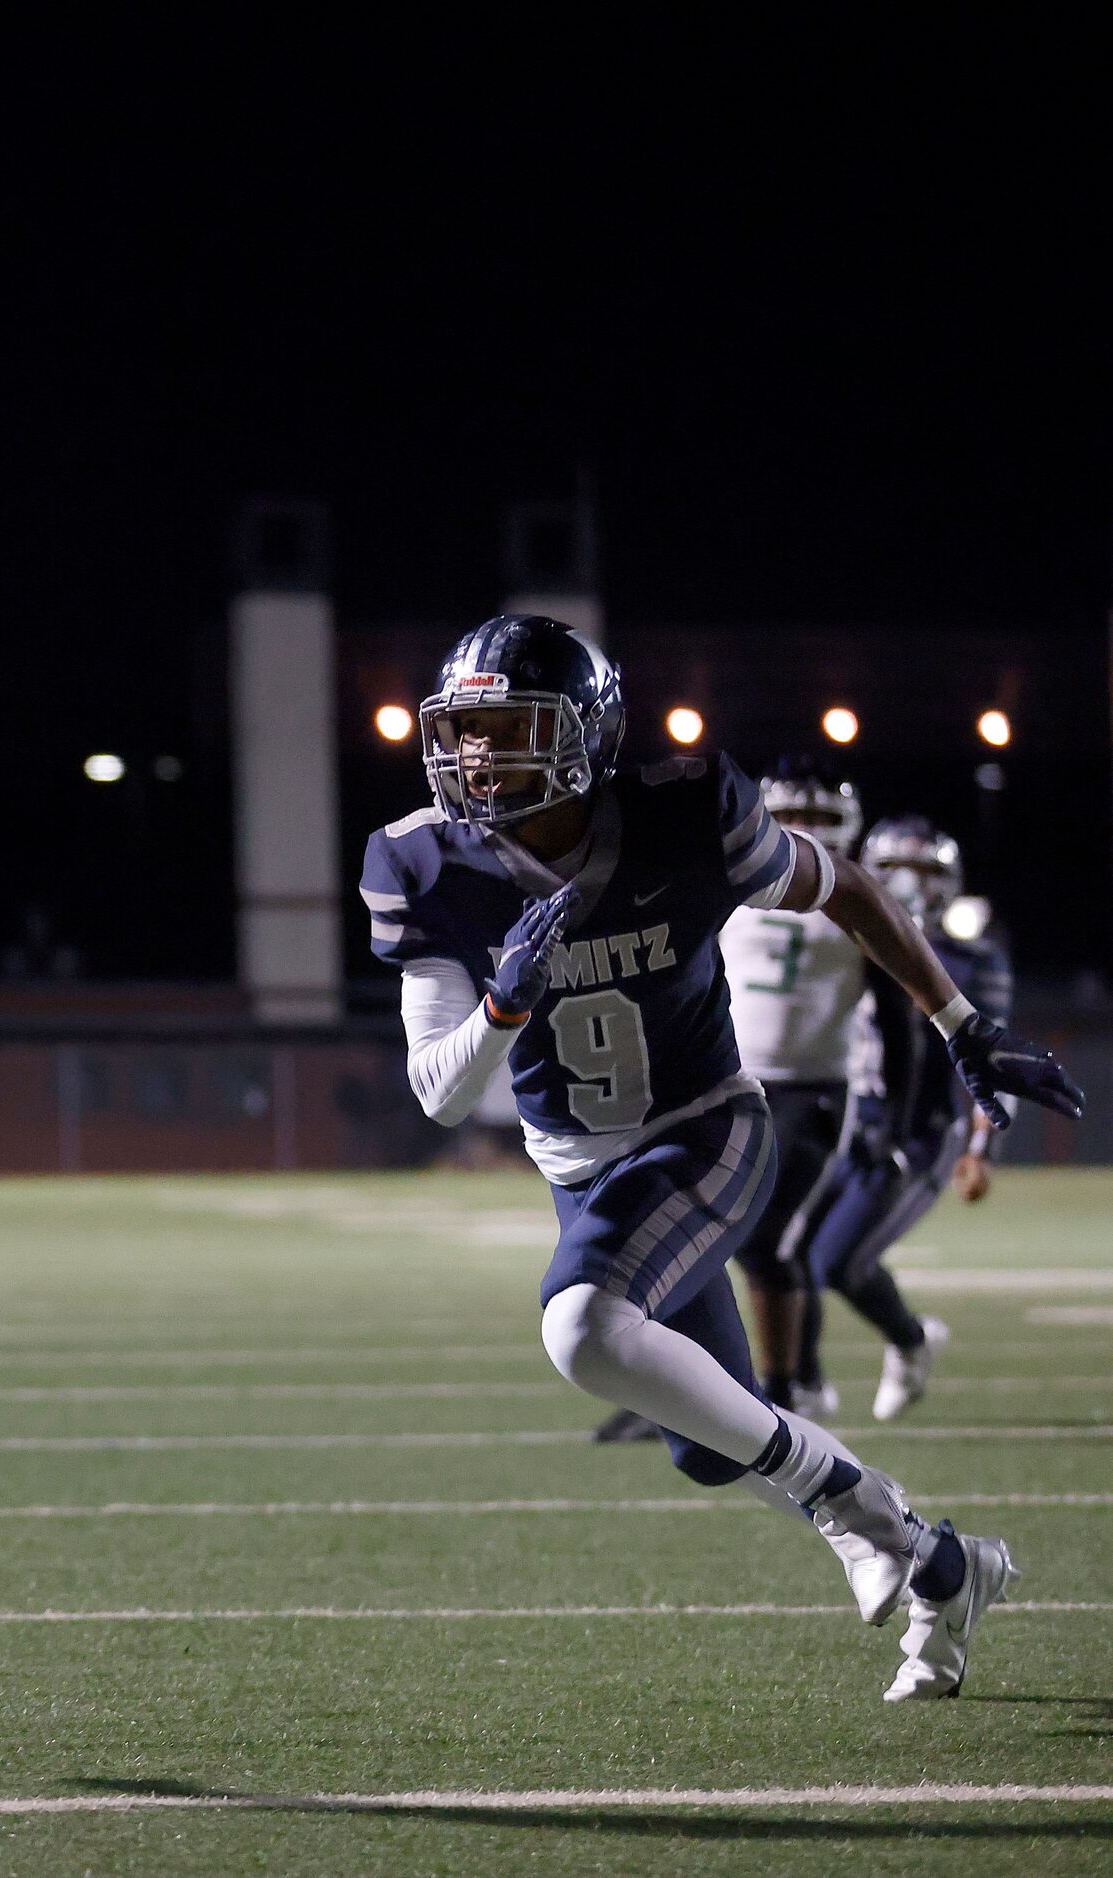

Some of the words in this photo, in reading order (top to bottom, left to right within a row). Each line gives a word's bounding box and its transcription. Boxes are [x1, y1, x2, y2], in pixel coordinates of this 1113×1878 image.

[486, 922, 677, 991] MITZ
[746, 918, 804, 993] 3
[548, 988, 654, 1133] 9
